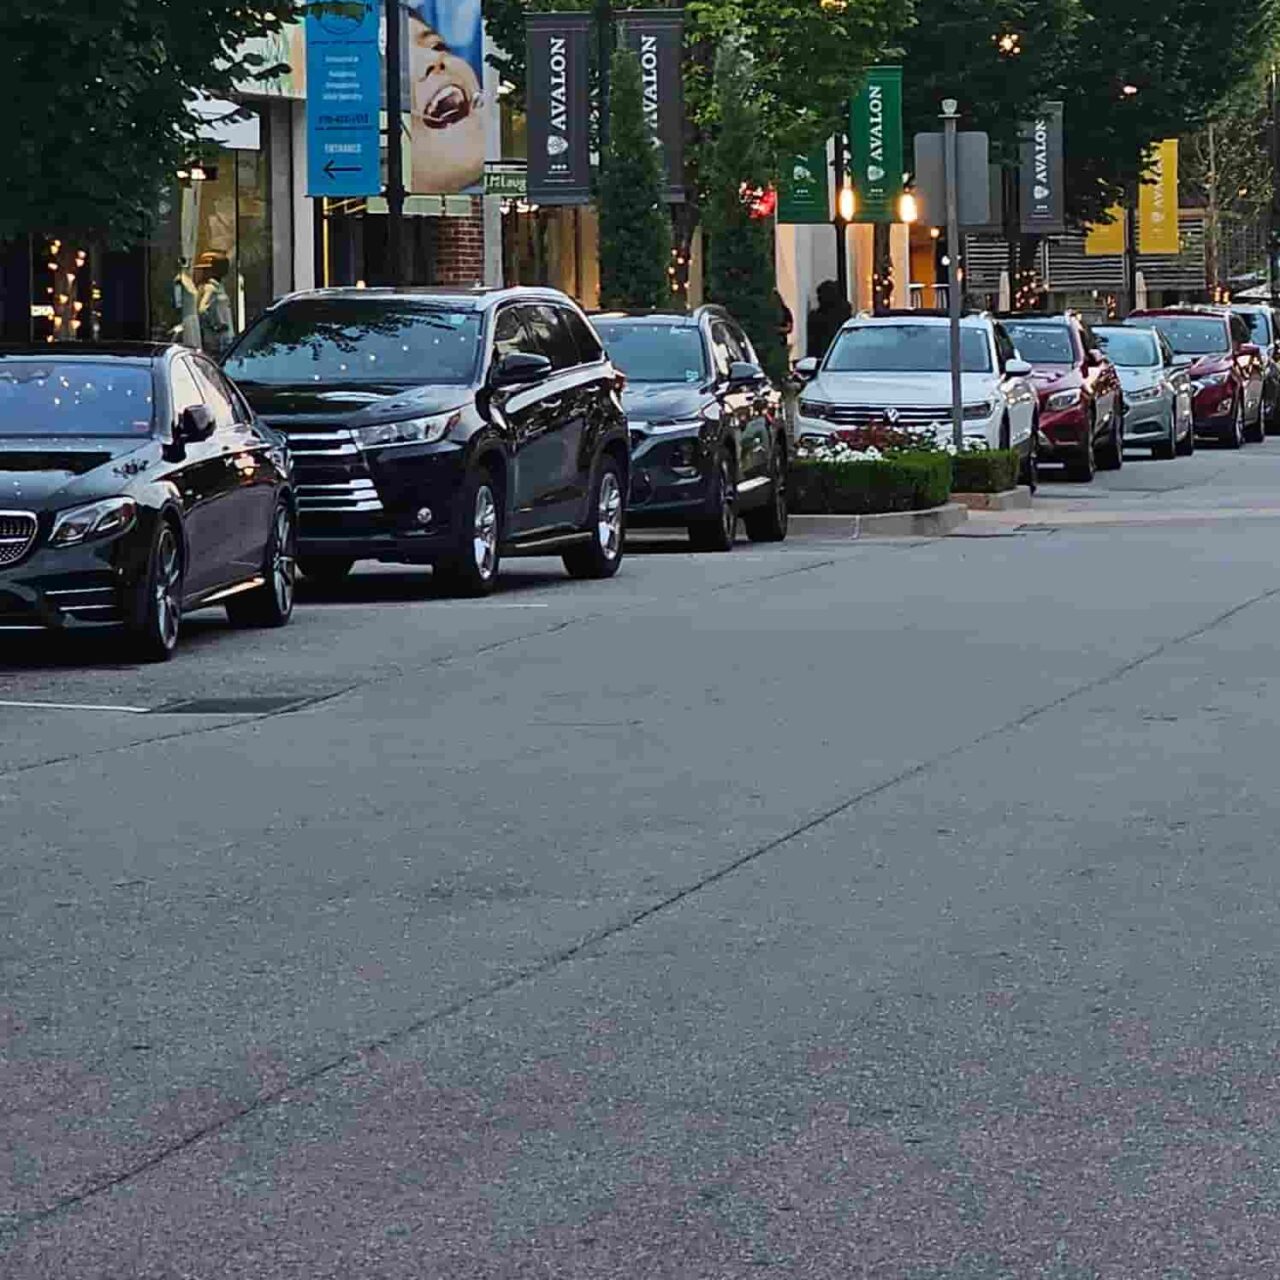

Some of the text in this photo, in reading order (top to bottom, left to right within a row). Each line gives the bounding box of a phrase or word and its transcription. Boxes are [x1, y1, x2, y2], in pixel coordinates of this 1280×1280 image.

[549, 37, 566, 131] AVALON
[641, 35, 658, 129] AVALON
[868, 85, 884, 161] AVALON
